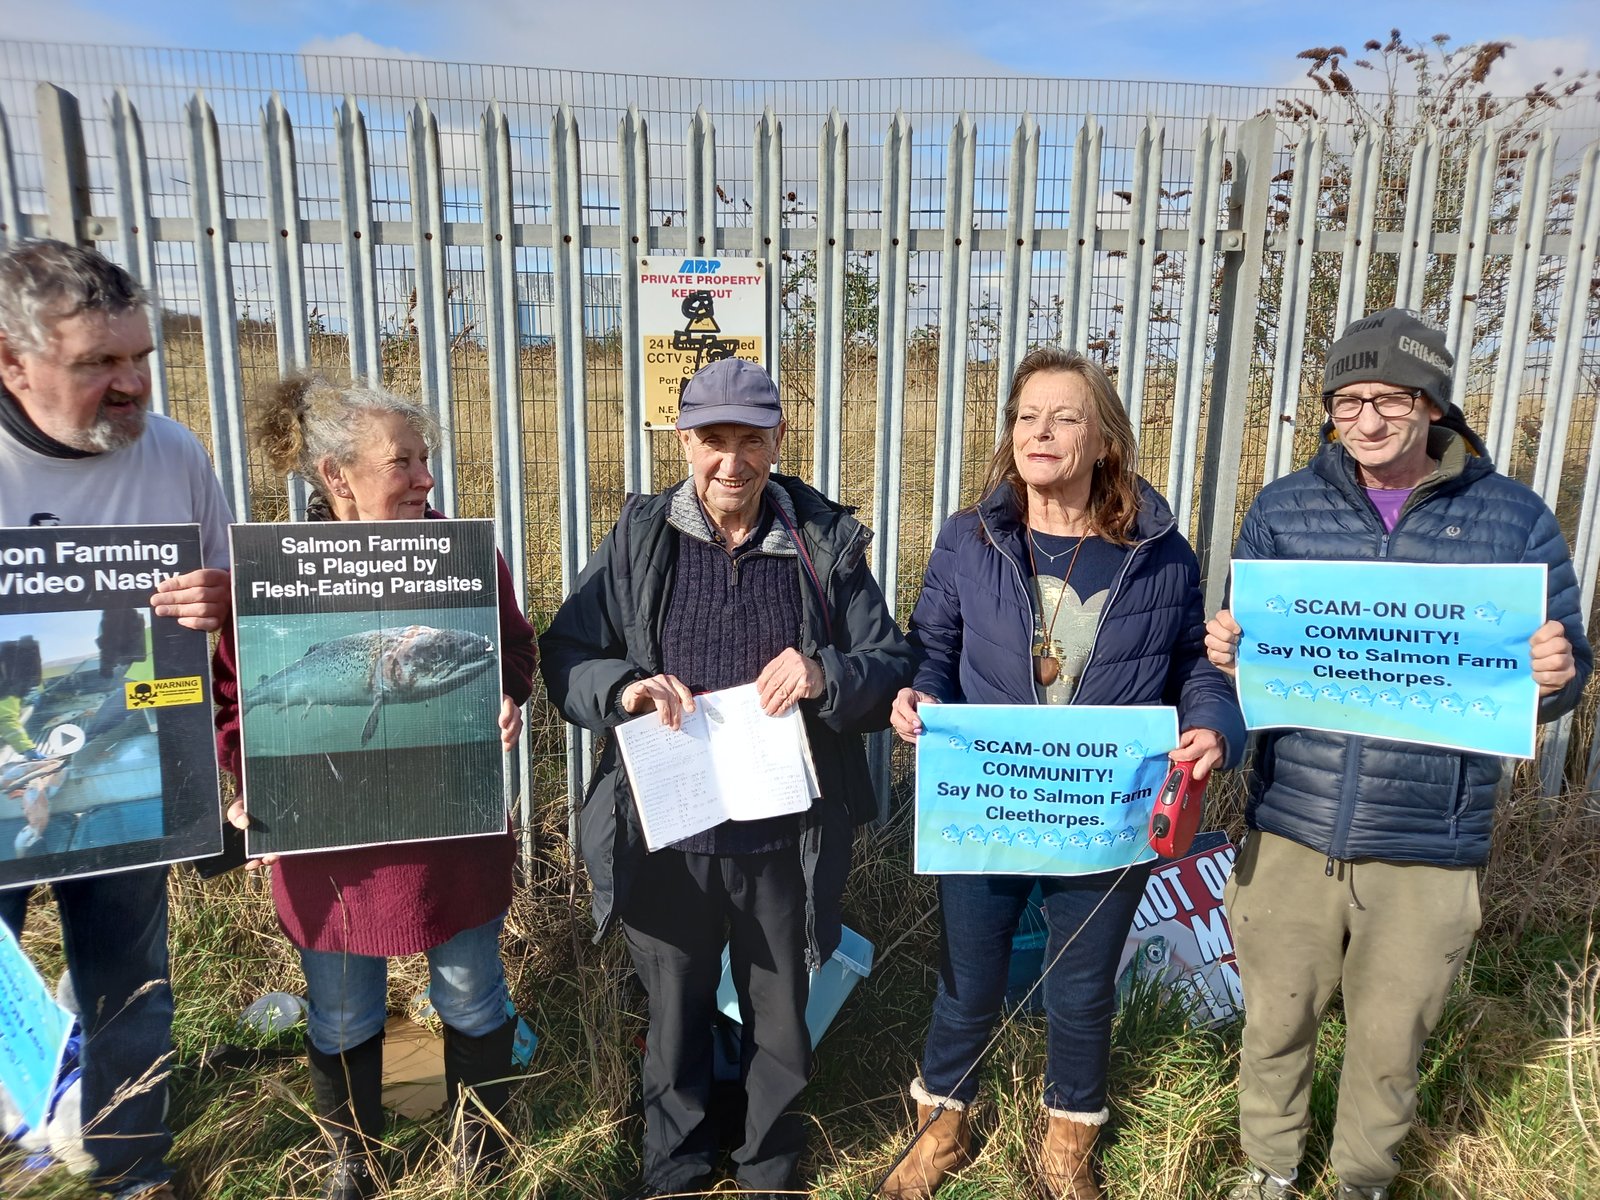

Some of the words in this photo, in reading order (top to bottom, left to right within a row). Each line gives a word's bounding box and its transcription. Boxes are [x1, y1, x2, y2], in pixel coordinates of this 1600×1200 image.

[678, 259, 721, 274] ABP
[641, 274, 692, 285] PRIVATE
[697, 275, 761, 285] PROPERTY
[649, 339, 664, 350] 24
[647, 353, 682, 364] CCTV
[659, 376, 679, 385] Port
[658, 406, 677, 414] N.E.
[0, 546, 46, 566] on
[55, 540, 178, 566] Farming
[281, 536, 361, 554] Salmon
[368, 534, 451, 554] Farming
[298, 558, 317, 575] is
[323, 556, 407, 577] Plagued
[413, 556, 438, 575] by
[0, 572, 85, 595] Video
[251, 578, 384, 598] Flesh-Eating
[391, 576, 483, 594] Parasites
[1293, 598, 1407, 619] SCAM-ON
[1414, 602, 1466, 620] OUR
[1304, 624, 1460, 645] COMMUNITY!
[1256, 642, 1294, 659] Say
[1300, 645, 1331, 659] NO
[1338, 646, 1359, 661] to
[1365, 648, 1450, 665] Salmon
[1458, 652, 1518, 670] Farm
[154, 679, 198, 690] WARNING
[1313, 664, 1453, 688] Cleethorpes.
[973, 738, 1072, 758] SCAM-ON
[1076, 742, 1118, 759] OUR
[982, 761, 1114, 783] COMMUNITY!
[936, 782, 971, 801] Say
[976, 784, 1004, 799] NO
[1010, 785, 1028, 801] to
[1033, 787, 1105, 805] Salmon
[1110, 786, 1152, 805] Farm
[985, 806, 1105, 829] Cleethorpes.
